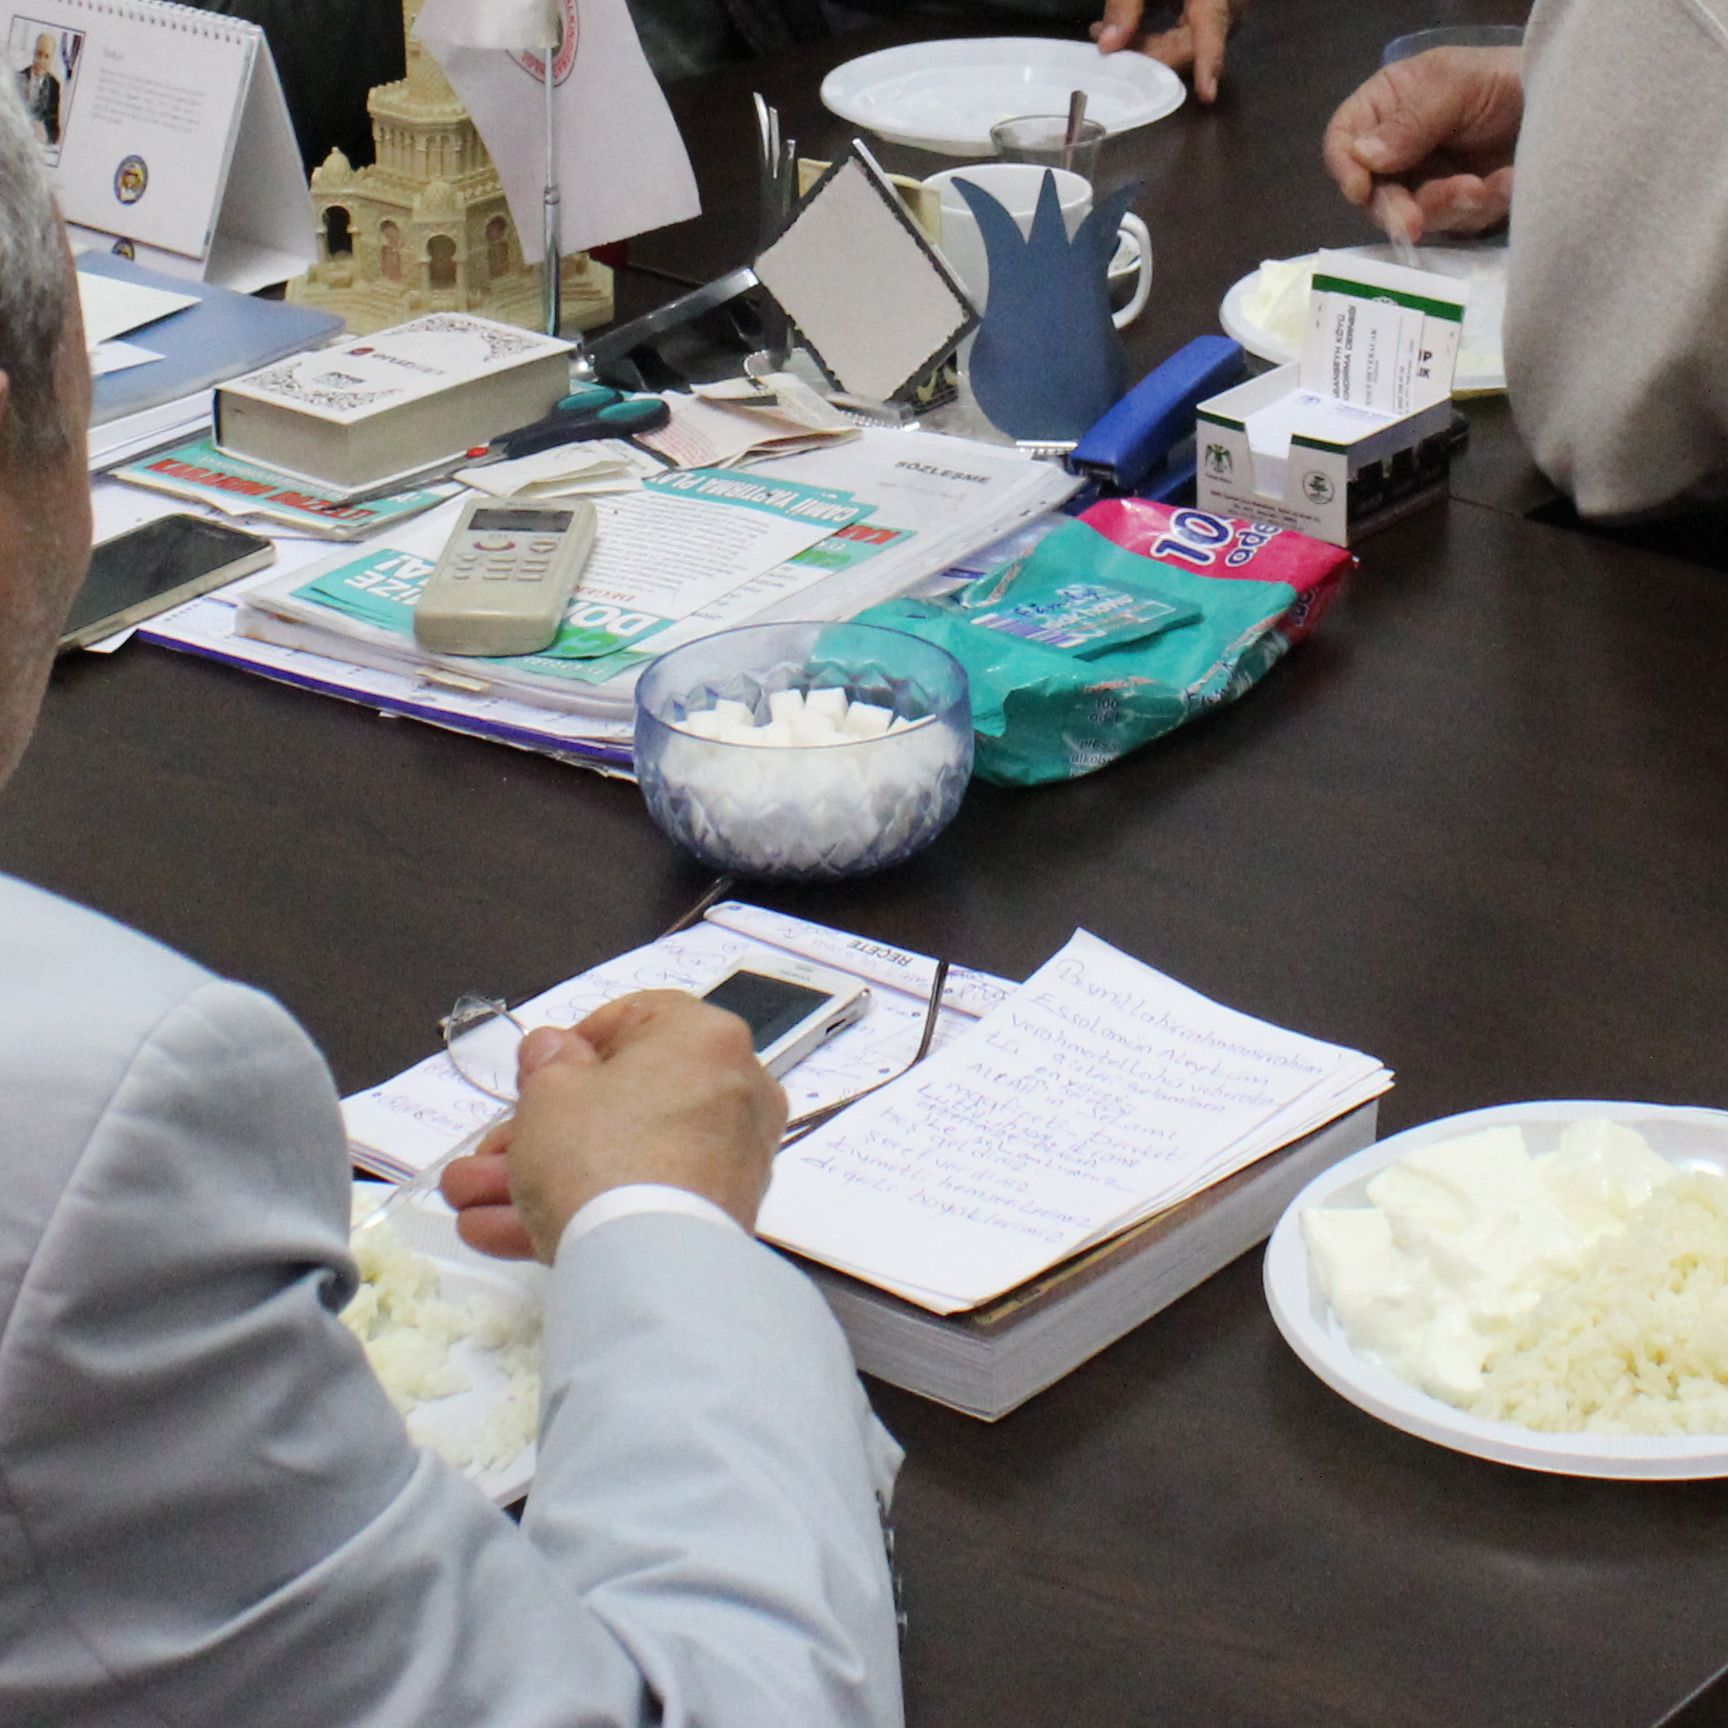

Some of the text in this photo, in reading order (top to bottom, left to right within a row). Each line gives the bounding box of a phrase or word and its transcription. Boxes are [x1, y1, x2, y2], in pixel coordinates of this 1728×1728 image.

[894, 460, 992, 486] SÖZLEŞME
[1150, 507, 1234, 566] 10
[1225, 523, 1282, 567] ade
[847, 939, 914, 969] REÇETE
